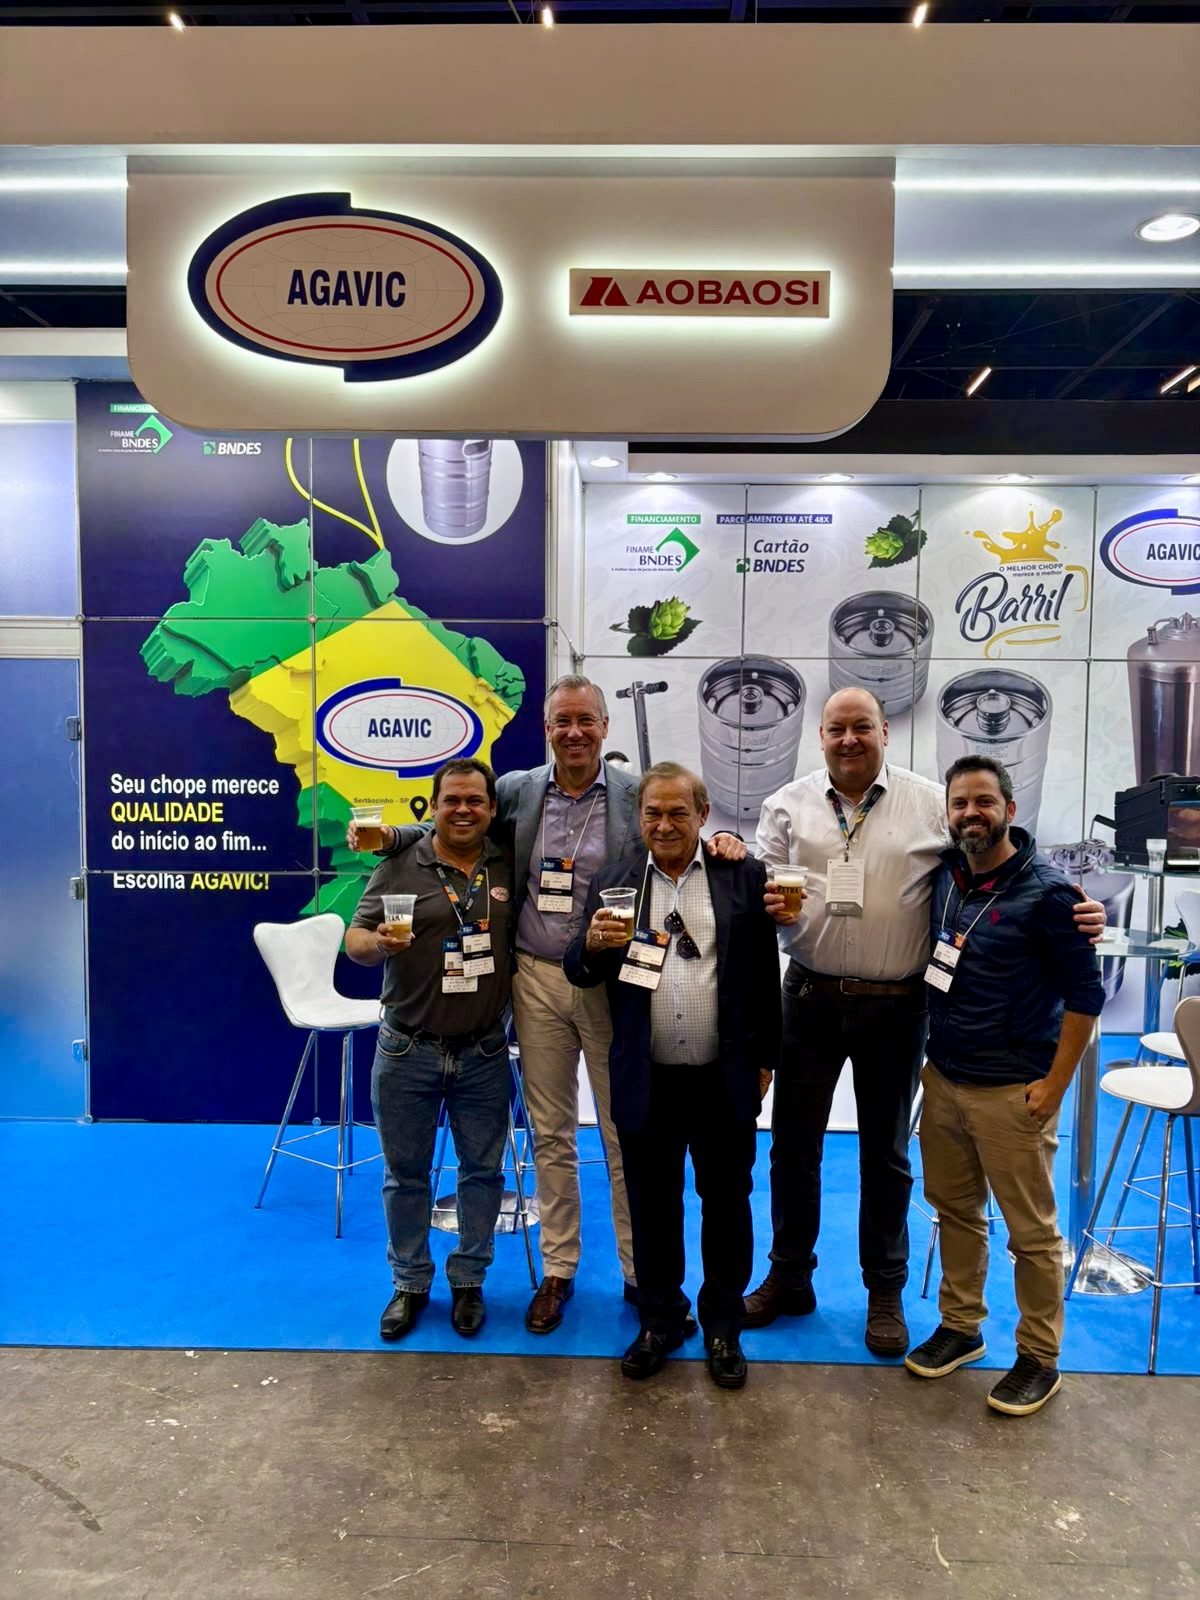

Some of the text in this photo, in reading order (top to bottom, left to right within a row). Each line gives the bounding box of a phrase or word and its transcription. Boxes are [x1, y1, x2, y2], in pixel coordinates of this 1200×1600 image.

[287, 269, 406, 308] AGAVIC
[636, 279, 820, 306] AOBAOSI
[110, 430, 135, 438] FINAME
[121, 438, 159, 448] BNDES
[217, 442, 262, 455] BNDES
[630, 515, 698, 523] FINANCIAMENTO
[785, 515, 797, 523] EM
[798, 514, 813, 523] ATÉ
[814, 515, 830, 523] 48X
[753, 539, 809, 553] Cartão
[1146, 543, 1200, 561] AGAVIC
[640, 555, 682, 566] BNDES
[753, 559, 805, 573] BNDES
[955, 571, 1074, 643] Barril
[367, 718, 432, 738] AGAVIC
[111, 773, 280, 798] Seu chope merece
[353, 796, 394, 804] Sertãozinho
[111, 802, 224, 823] QUALIDADE
[111, 830, 267, 851] do início ao fim...
[113, 872, 270, 890] Escolha AGAVIC!
